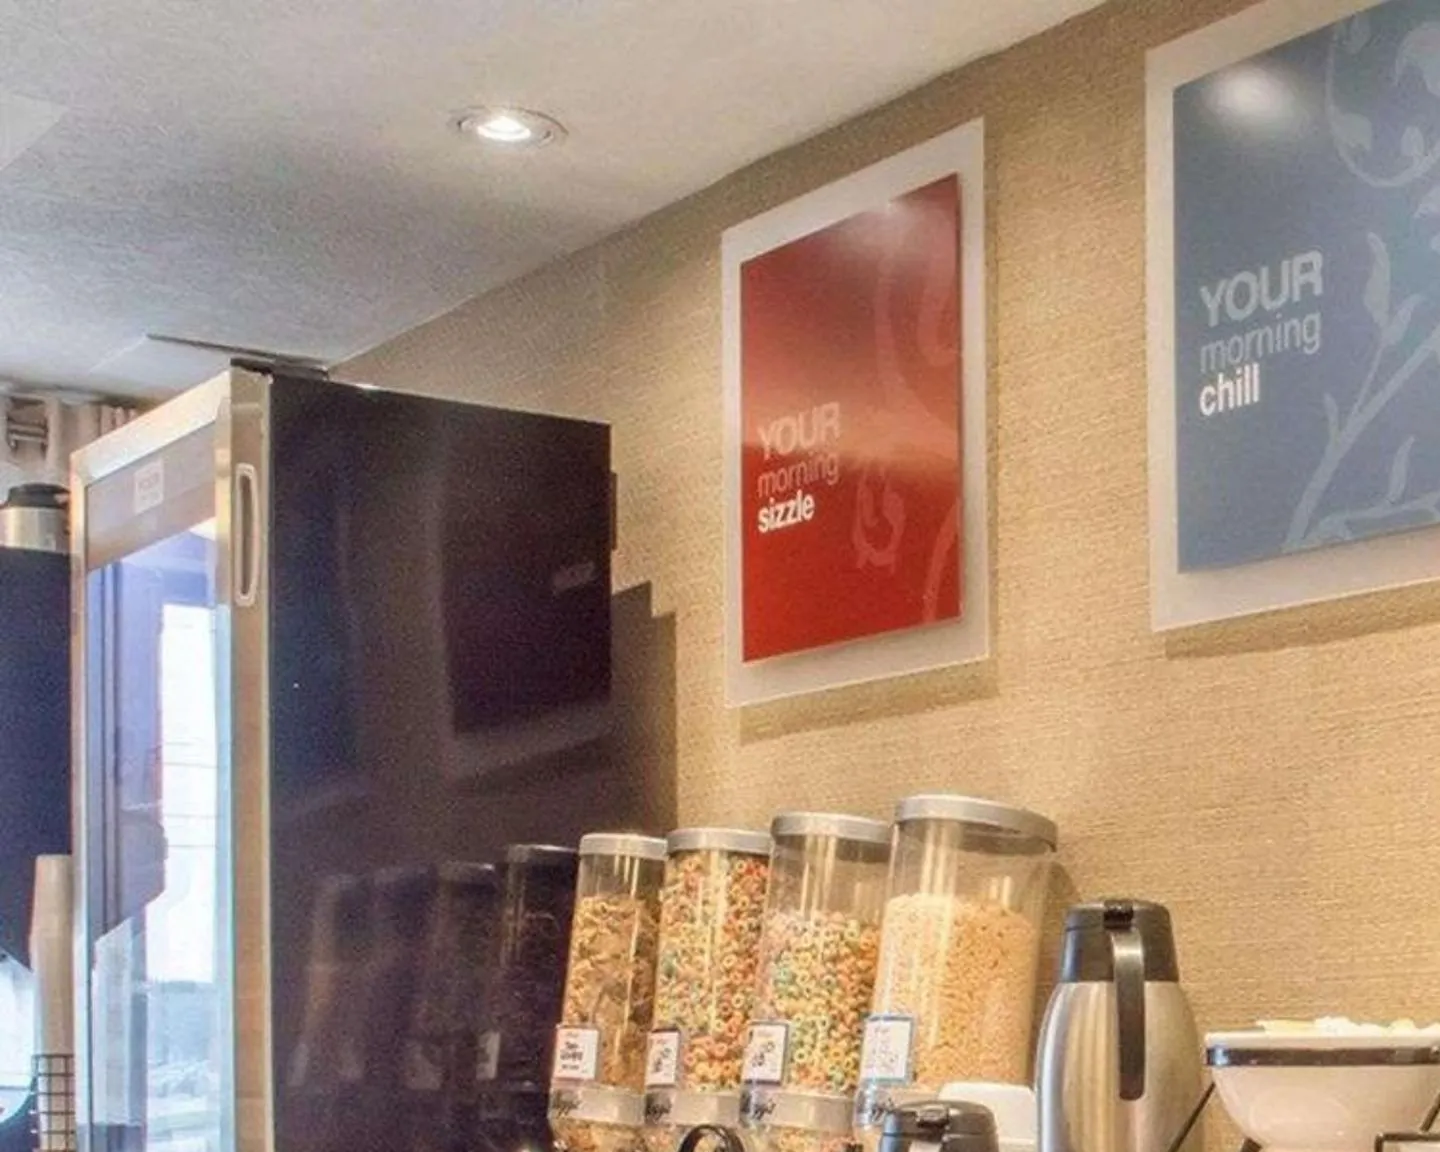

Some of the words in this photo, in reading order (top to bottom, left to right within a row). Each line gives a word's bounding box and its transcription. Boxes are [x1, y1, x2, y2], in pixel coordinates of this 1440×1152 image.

[1200, 250, 1323, 327] YOUR
[1201, 312, 1321, 374] morning
[1200, 363, 1259, 416] chill
[757, 402, 840, 461] YOUR
[757, 452, 839, 498] morning
[758, 489, 815, 533] sizzle
